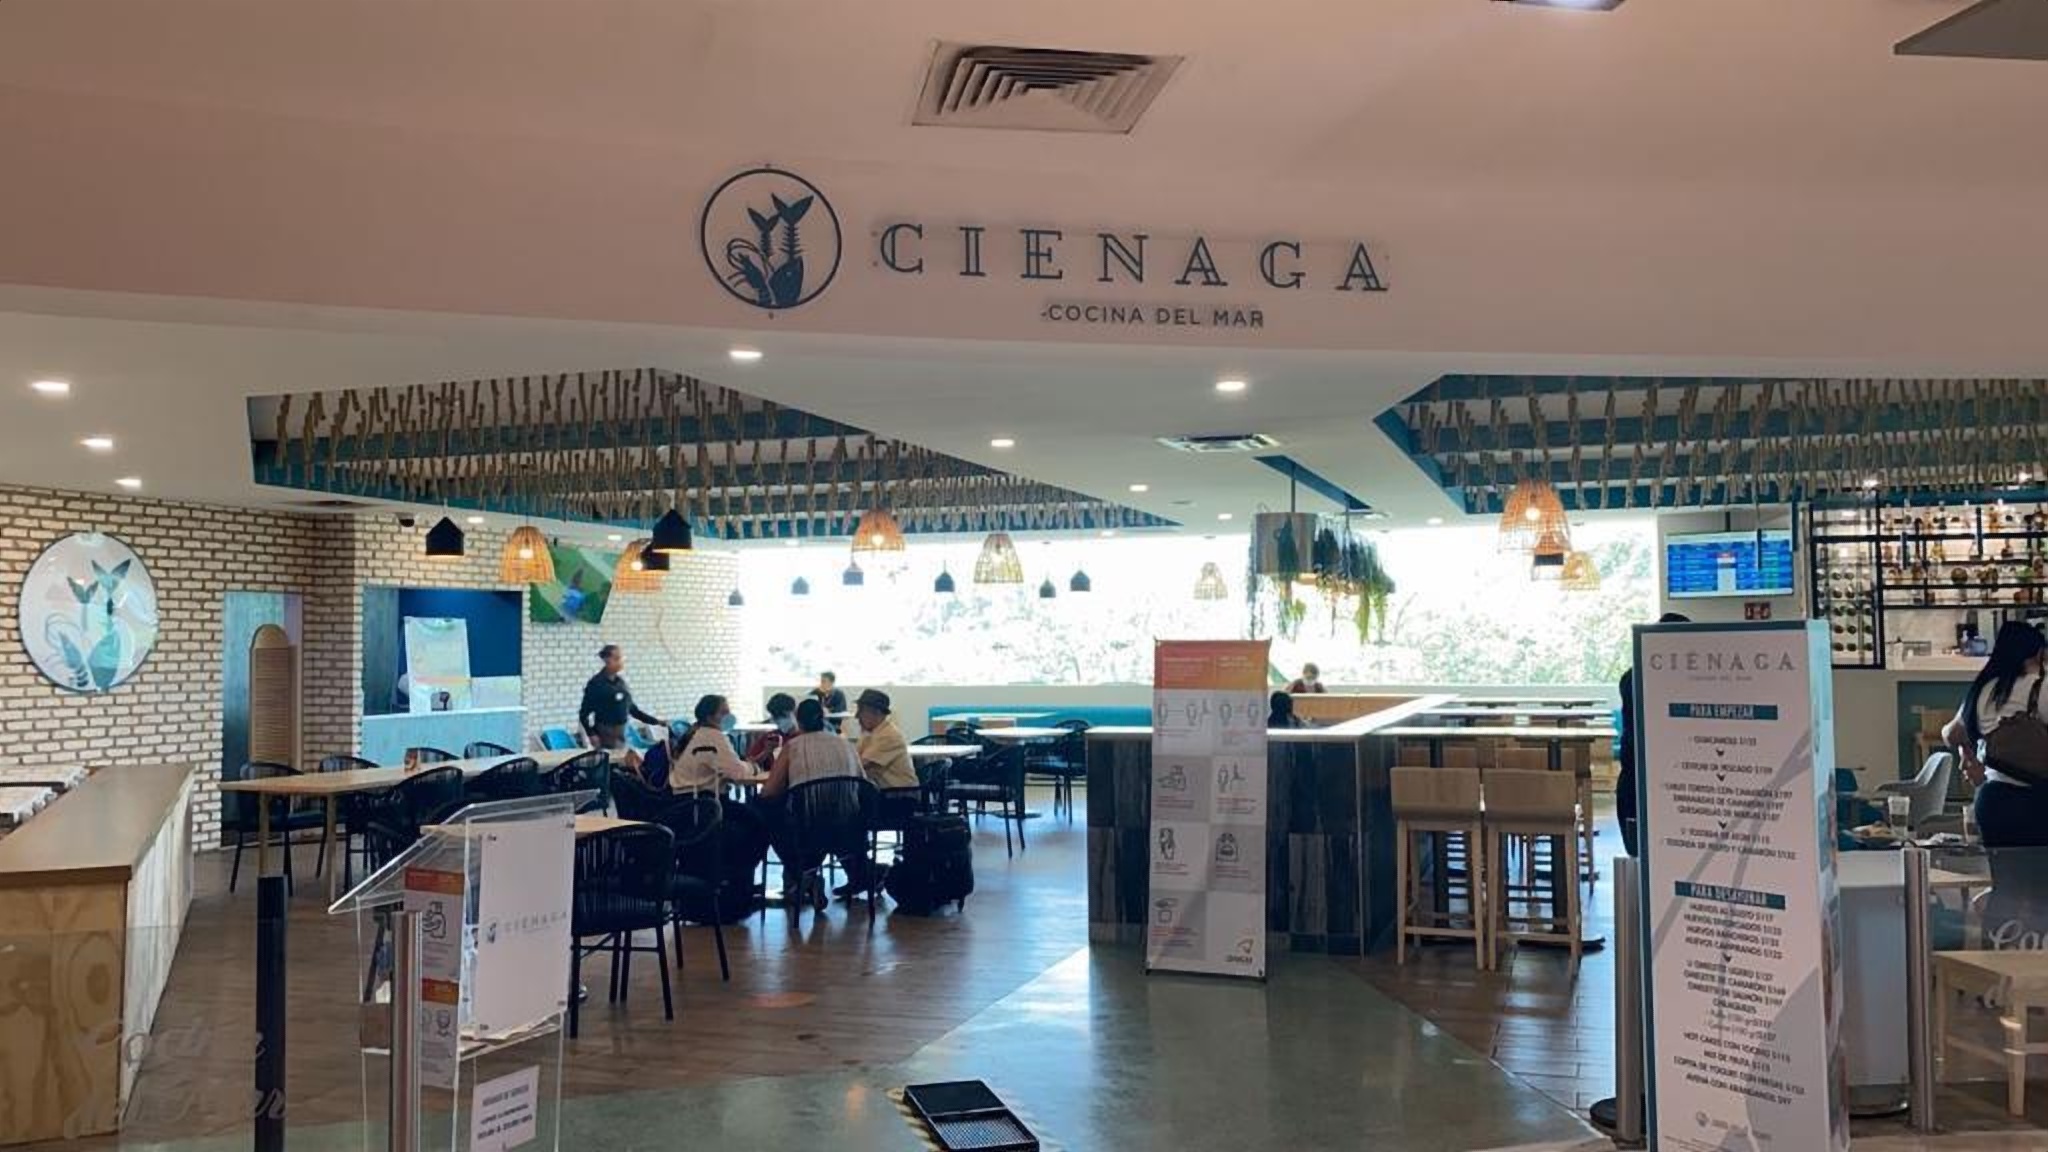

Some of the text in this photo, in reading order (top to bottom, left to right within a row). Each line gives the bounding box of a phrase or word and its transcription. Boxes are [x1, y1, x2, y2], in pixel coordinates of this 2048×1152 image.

[880, 223, 1388, 291] CIENAGA
[1049, 304, 1264, 328] COCINA DEL MAR
